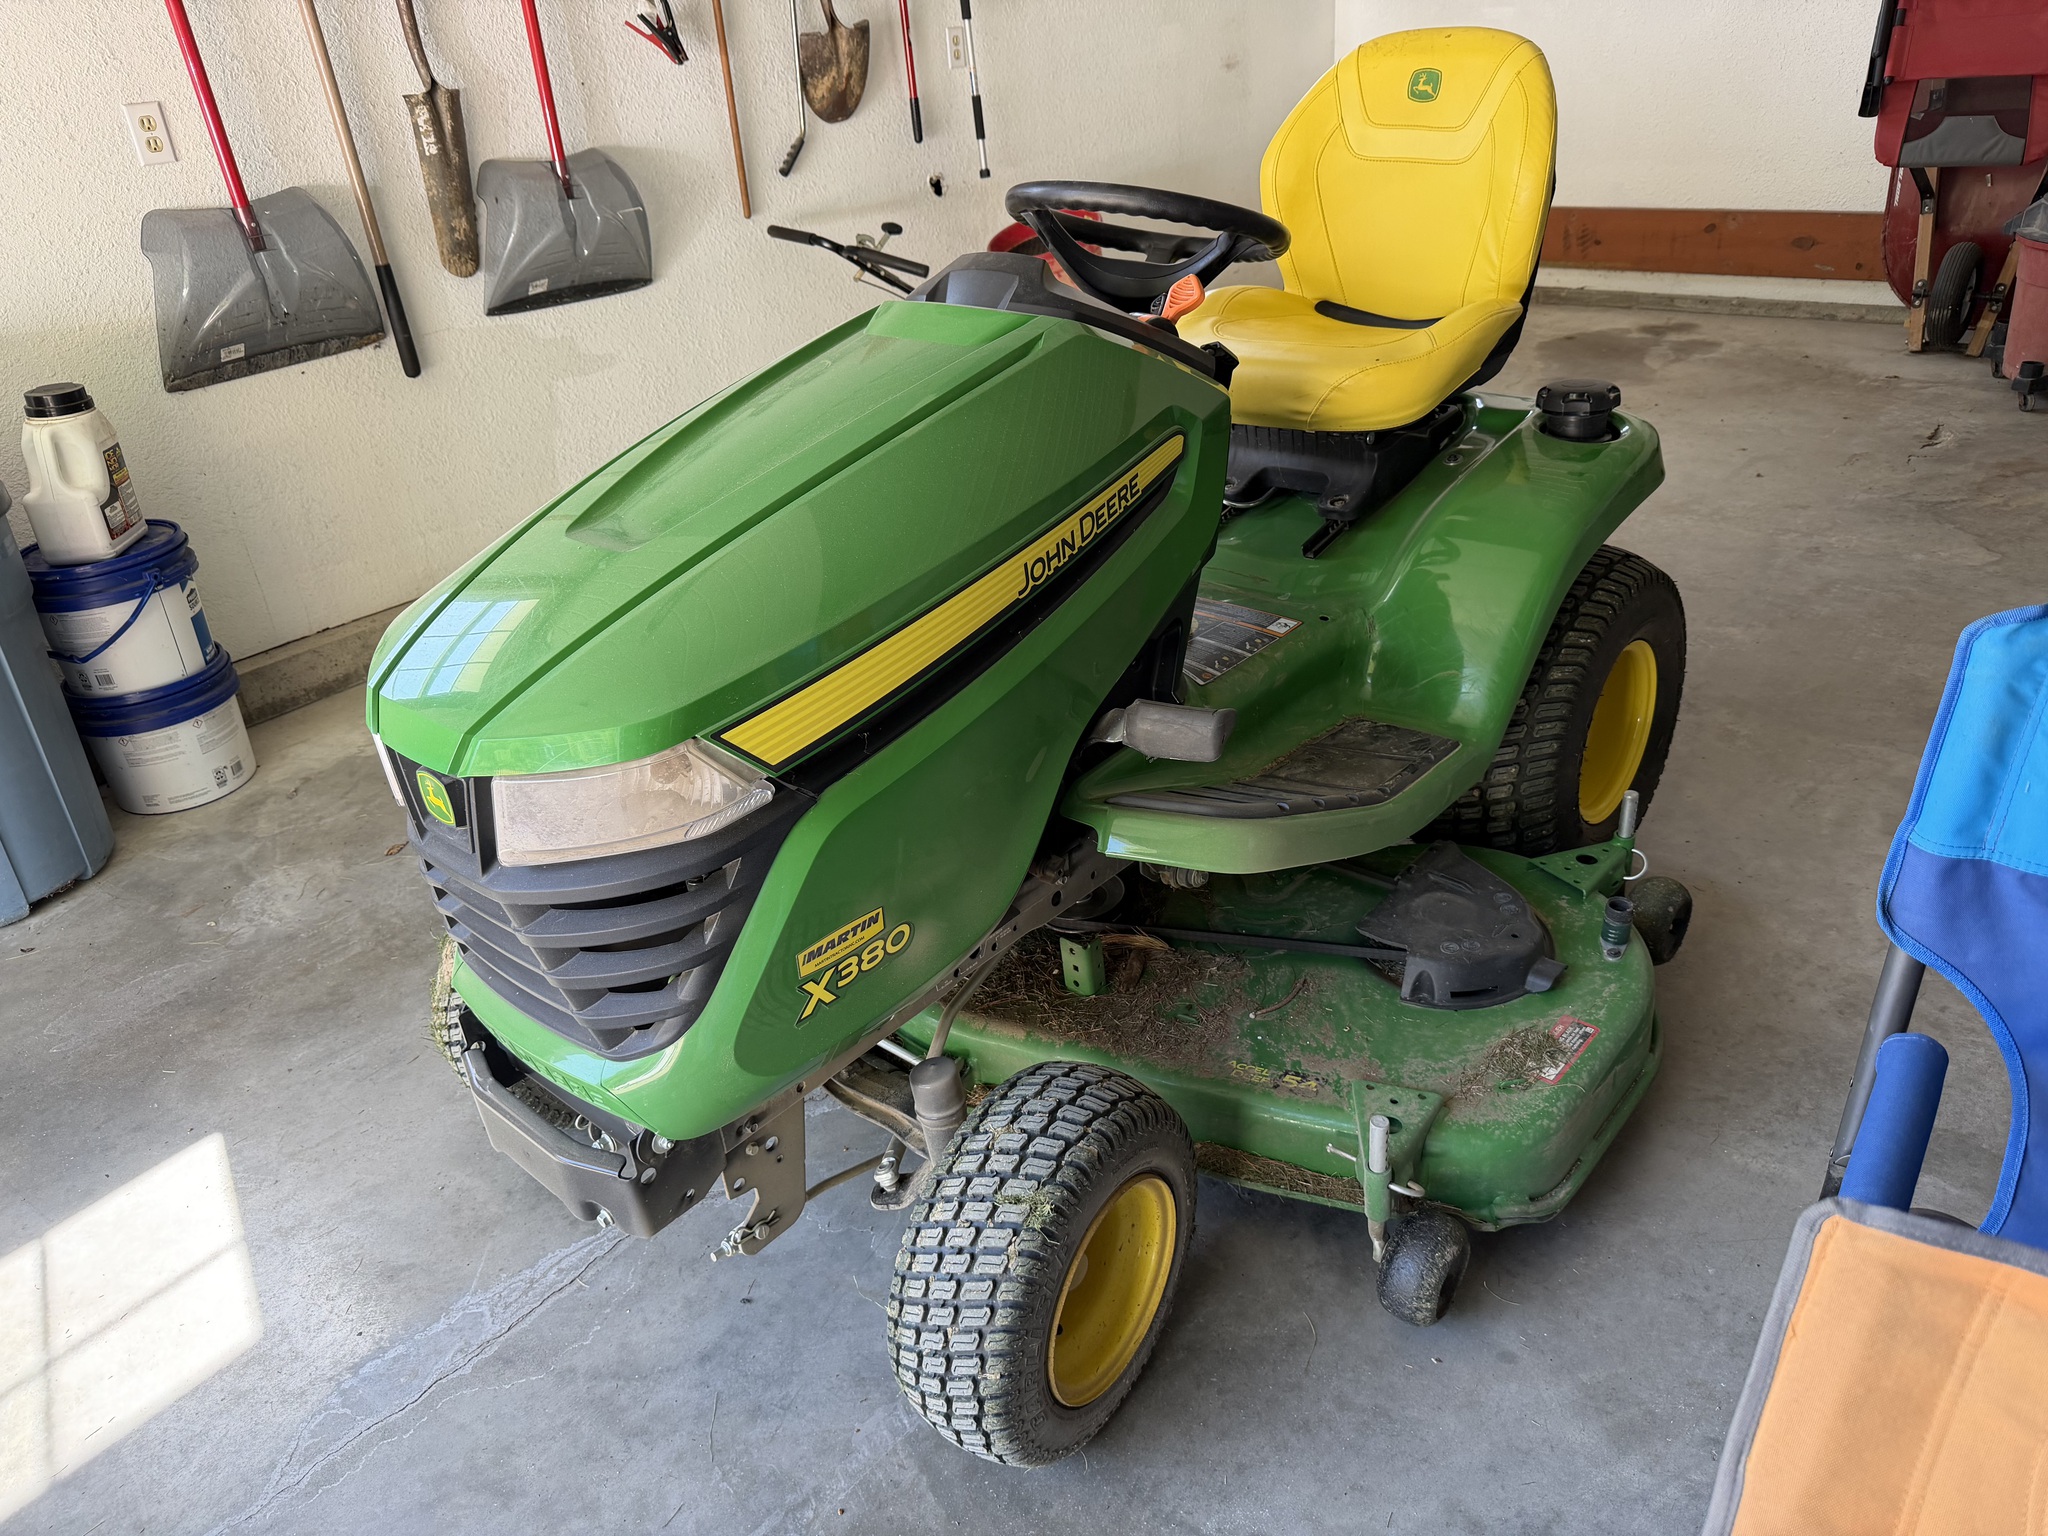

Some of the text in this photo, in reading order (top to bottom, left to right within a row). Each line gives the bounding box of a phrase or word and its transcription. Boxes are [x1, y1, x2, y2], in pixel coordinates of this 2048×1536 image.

[1018, 472, 1141, 597] JOHN DEERE
[798, 922, 912, 1022] X380
